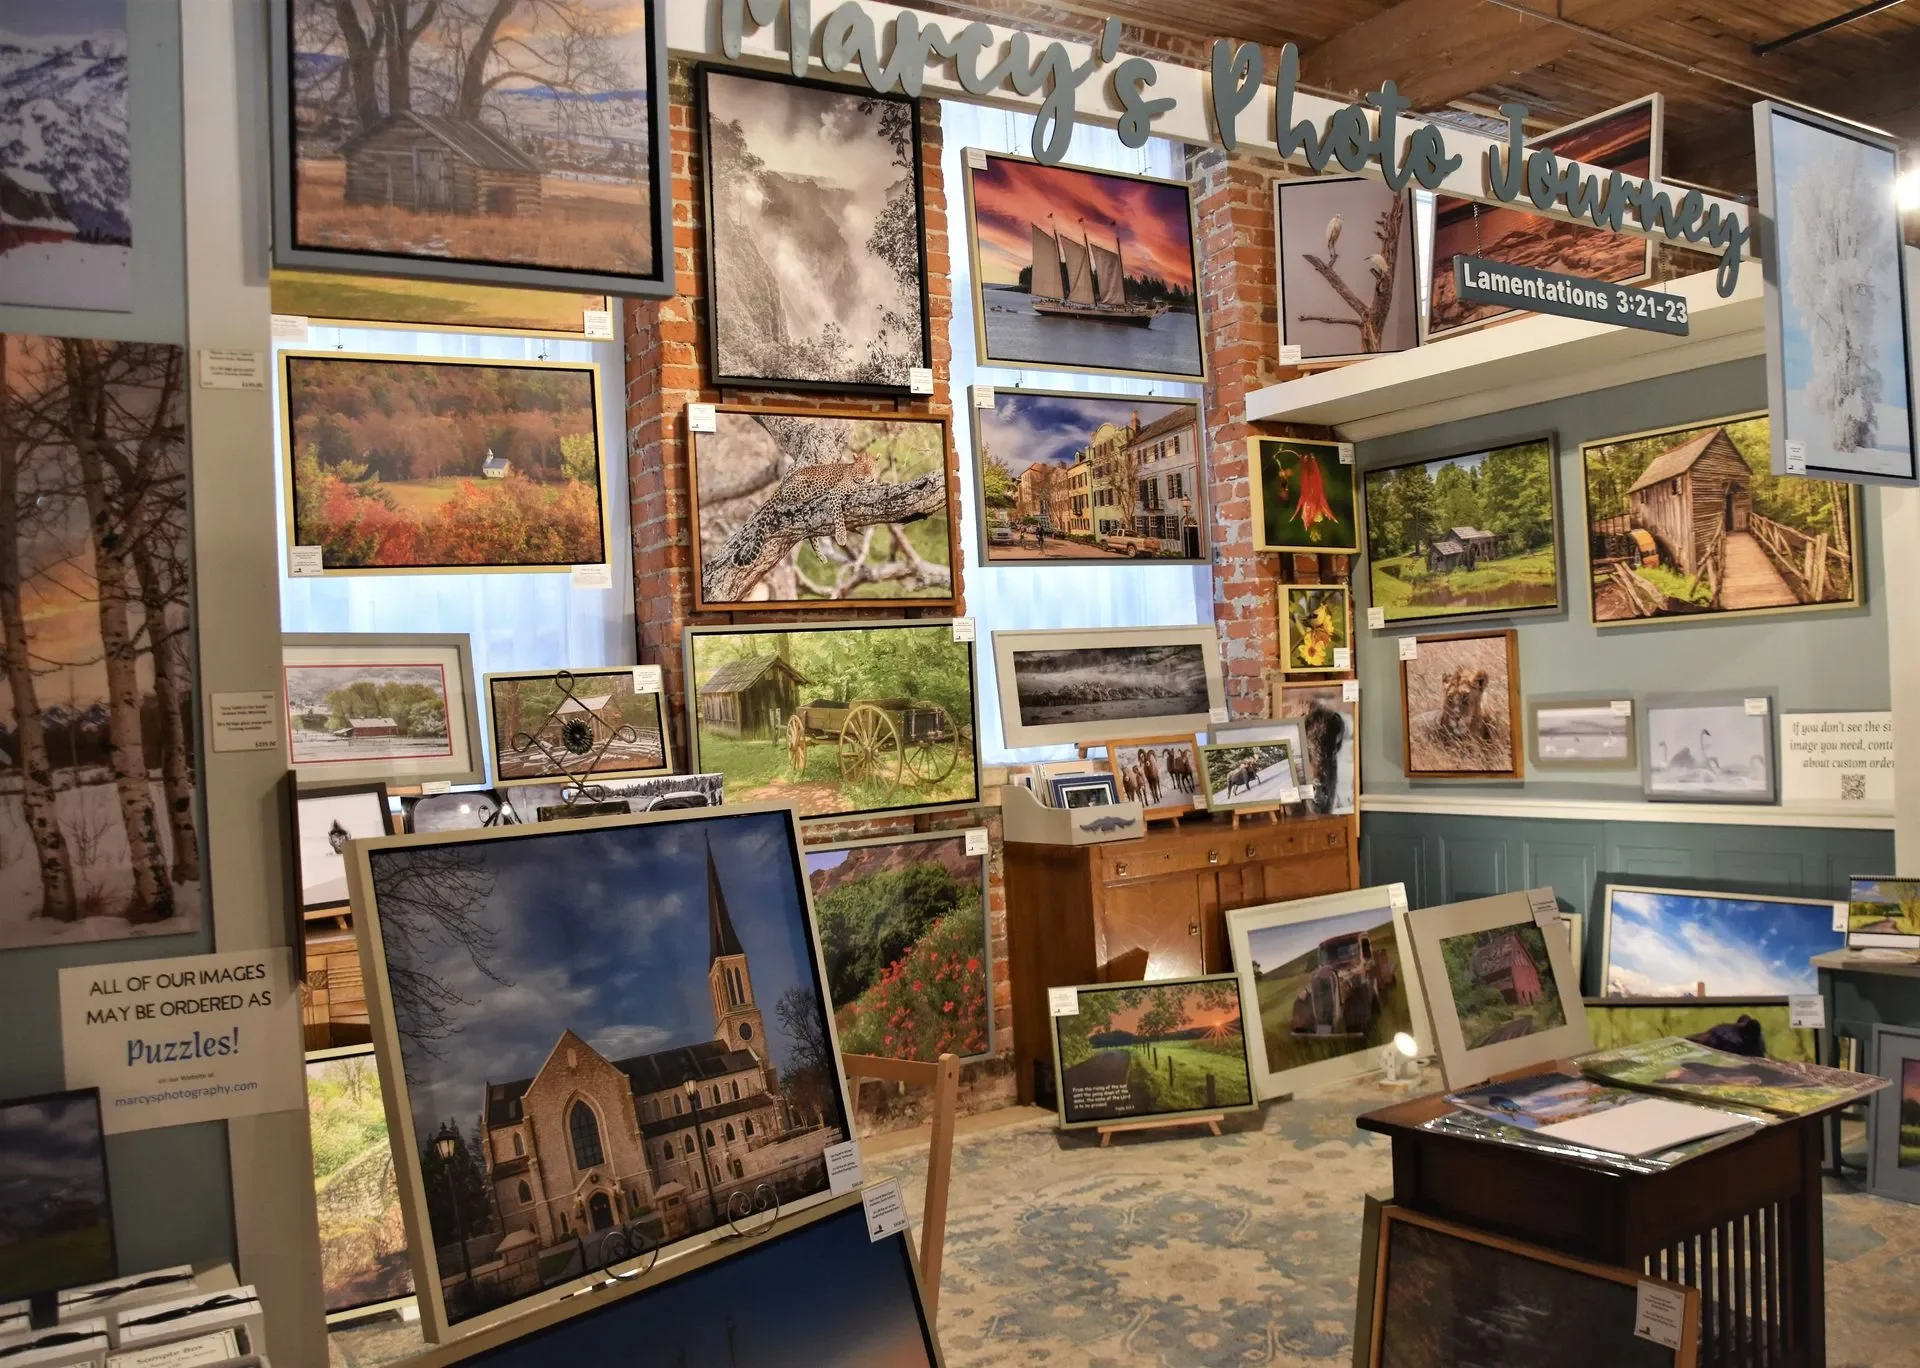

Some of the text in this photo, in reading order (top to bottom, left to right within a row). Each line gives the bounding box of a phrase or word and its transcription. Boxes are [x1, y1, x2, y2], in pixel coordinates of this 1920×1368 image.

[721, 0, 1751, 299] Marcy's Photo Journey
[1463, 262, 1689, 325] Lamentations 3:21-23
[1801, 724, 1819, 736] you
[1821, 720, 1845, 733] don't
[1847, 723, 1862, 733] see
[1864, 720, 1881, 733] the
[1790, 740, 1818, 754] image
[1820, 742, 1838, 754] you
[1840, 739, 1866, 752] need,
[1803, 757, 1830, 769] about
[1832, 758, 1868, 769] custom
[89, 963, 266, 997] ALL OF OUR IMAGES
[86, 991, 272, 1025] MAY BE ORDERED AS
[115, 1081, 258, 1108] marcysphotography.com
